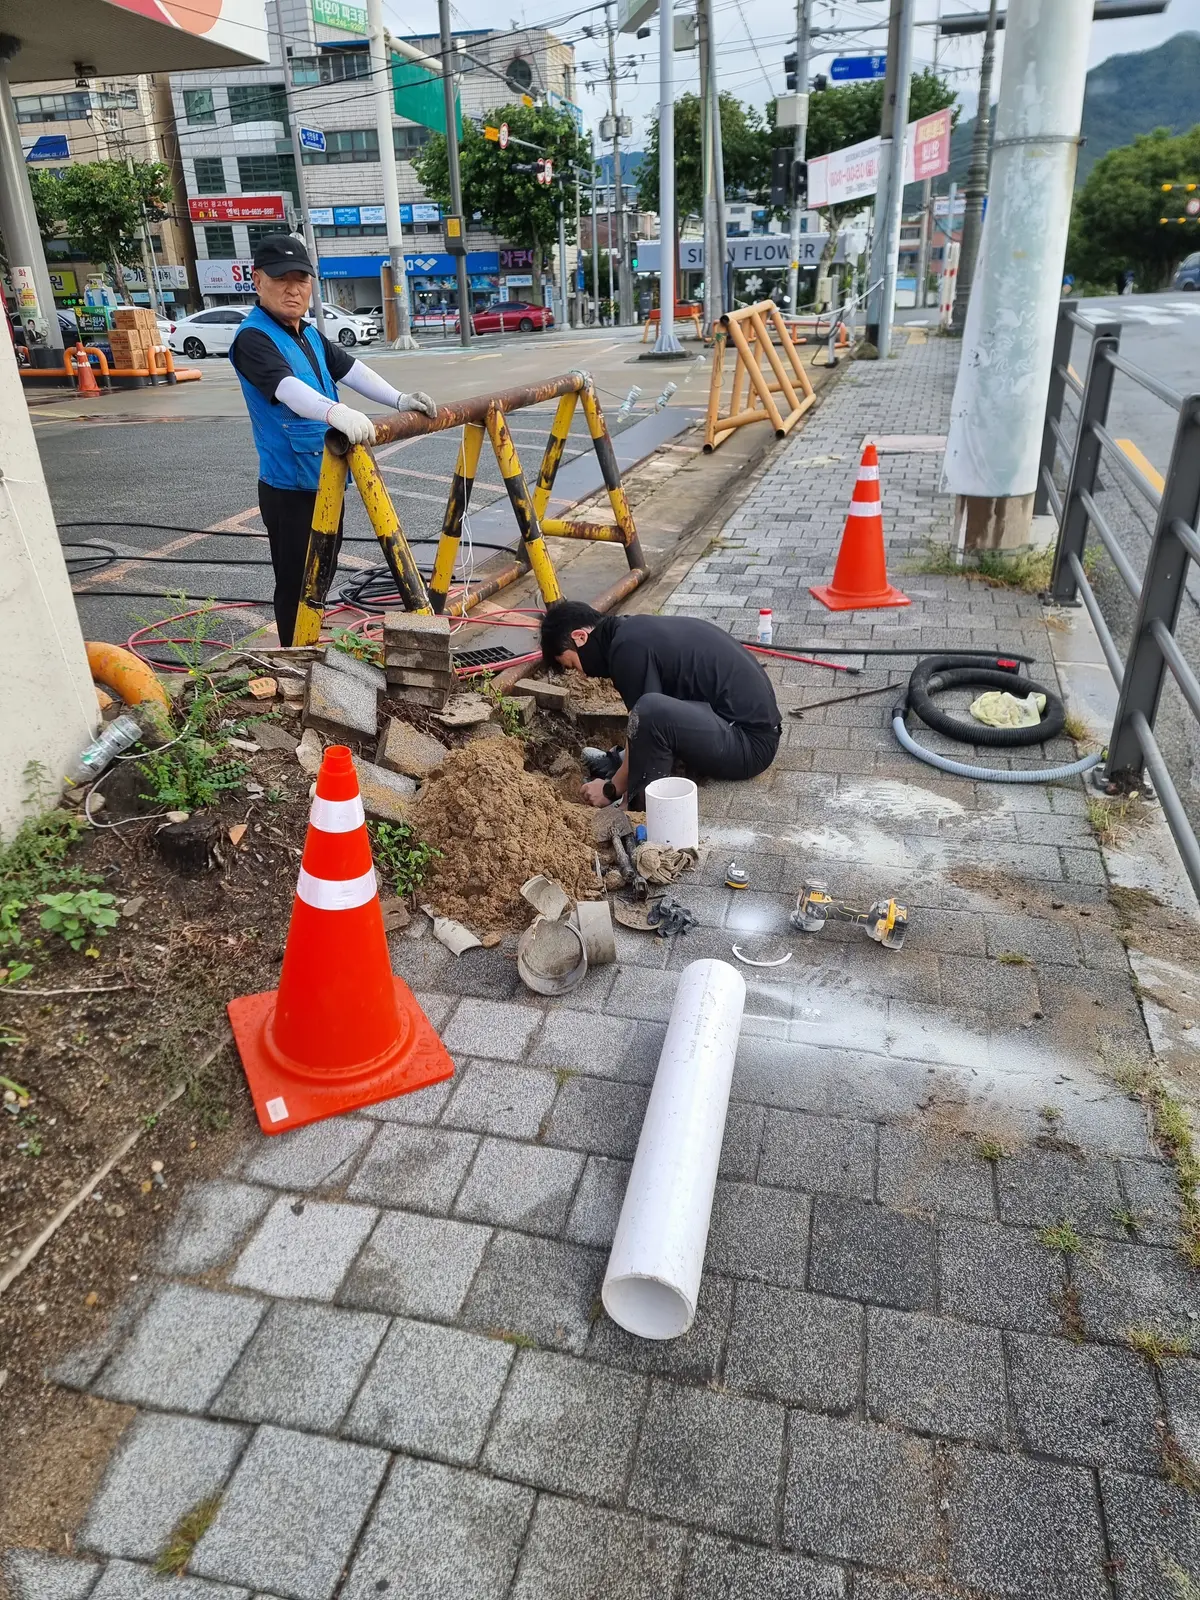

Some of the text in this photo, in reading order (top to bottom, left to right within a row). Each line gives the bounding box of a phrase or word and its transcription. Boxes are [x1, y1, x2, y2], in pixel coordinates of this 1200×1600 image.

[342, 5, 369, 25] 파크골
[211, 200, 234, 208] 광고대행
[688, 247, 736, 263] SIN
[231, 265, 255, 282] SE
